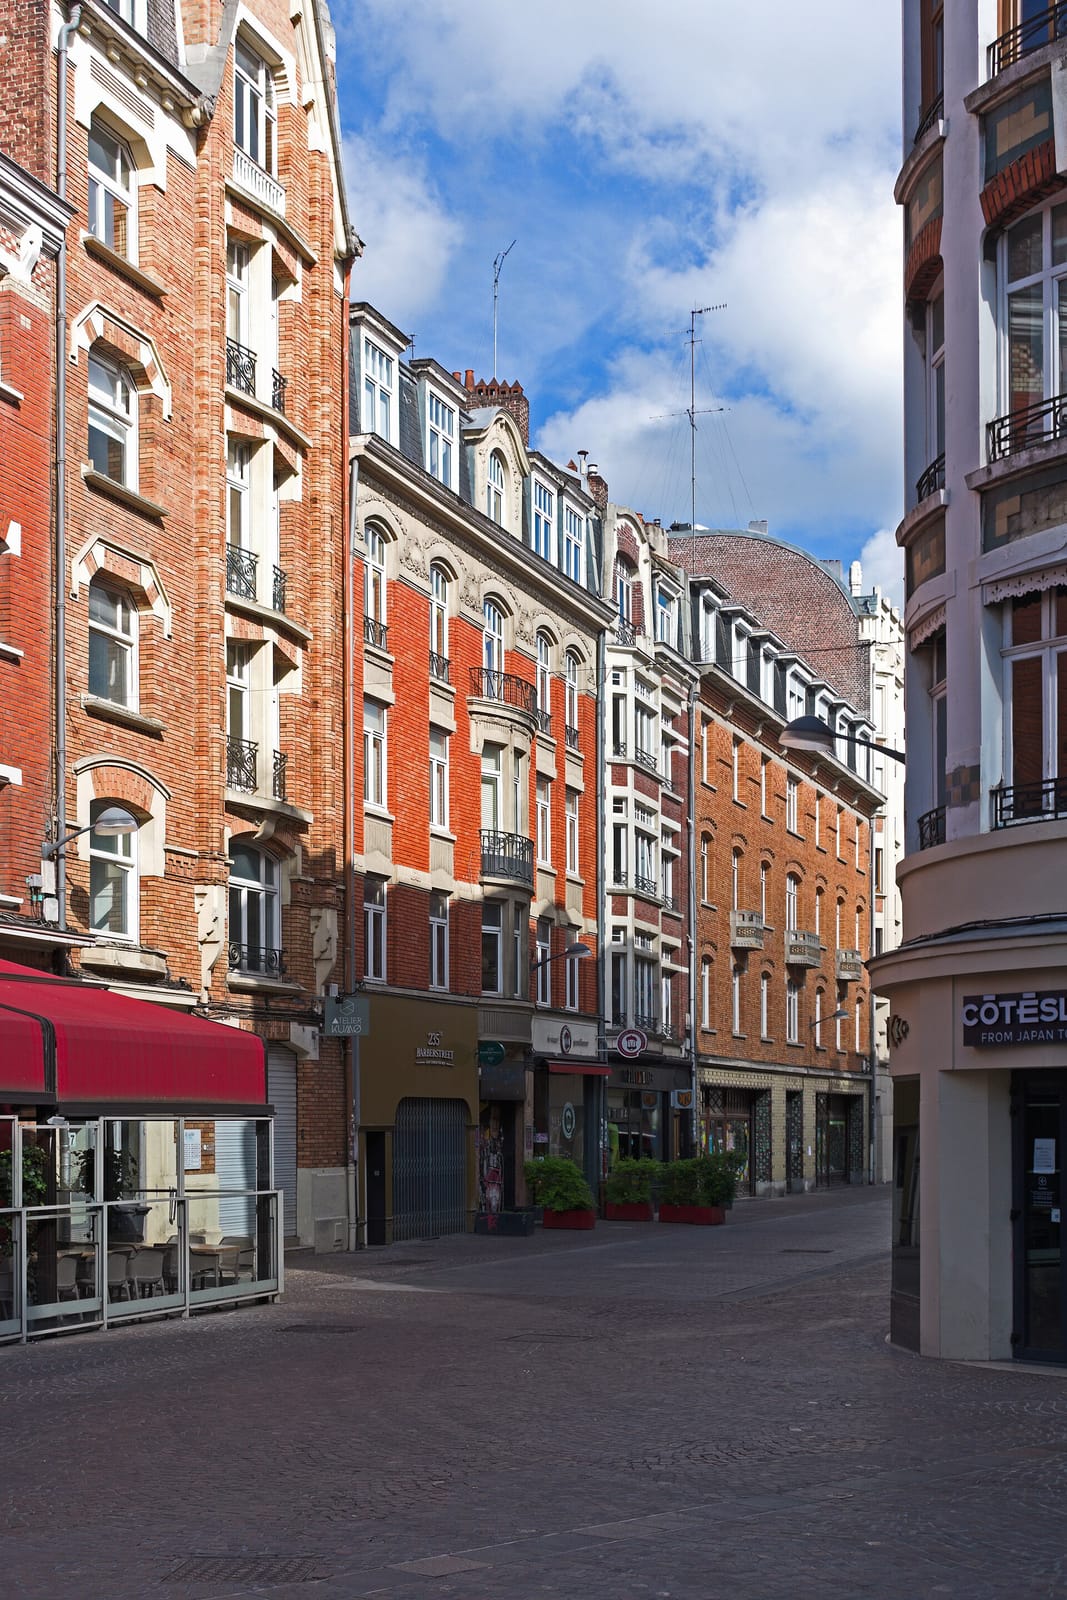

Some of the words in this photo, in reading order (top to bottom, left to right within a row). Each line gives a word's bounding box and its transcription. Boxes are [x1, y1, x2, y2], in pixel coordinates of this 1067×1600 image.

[981, 1031, 1013, 1043] FROM
[1017, 1029, 1054, 1042] JAPAN
[1057, 1028, 1067, 1040] T
